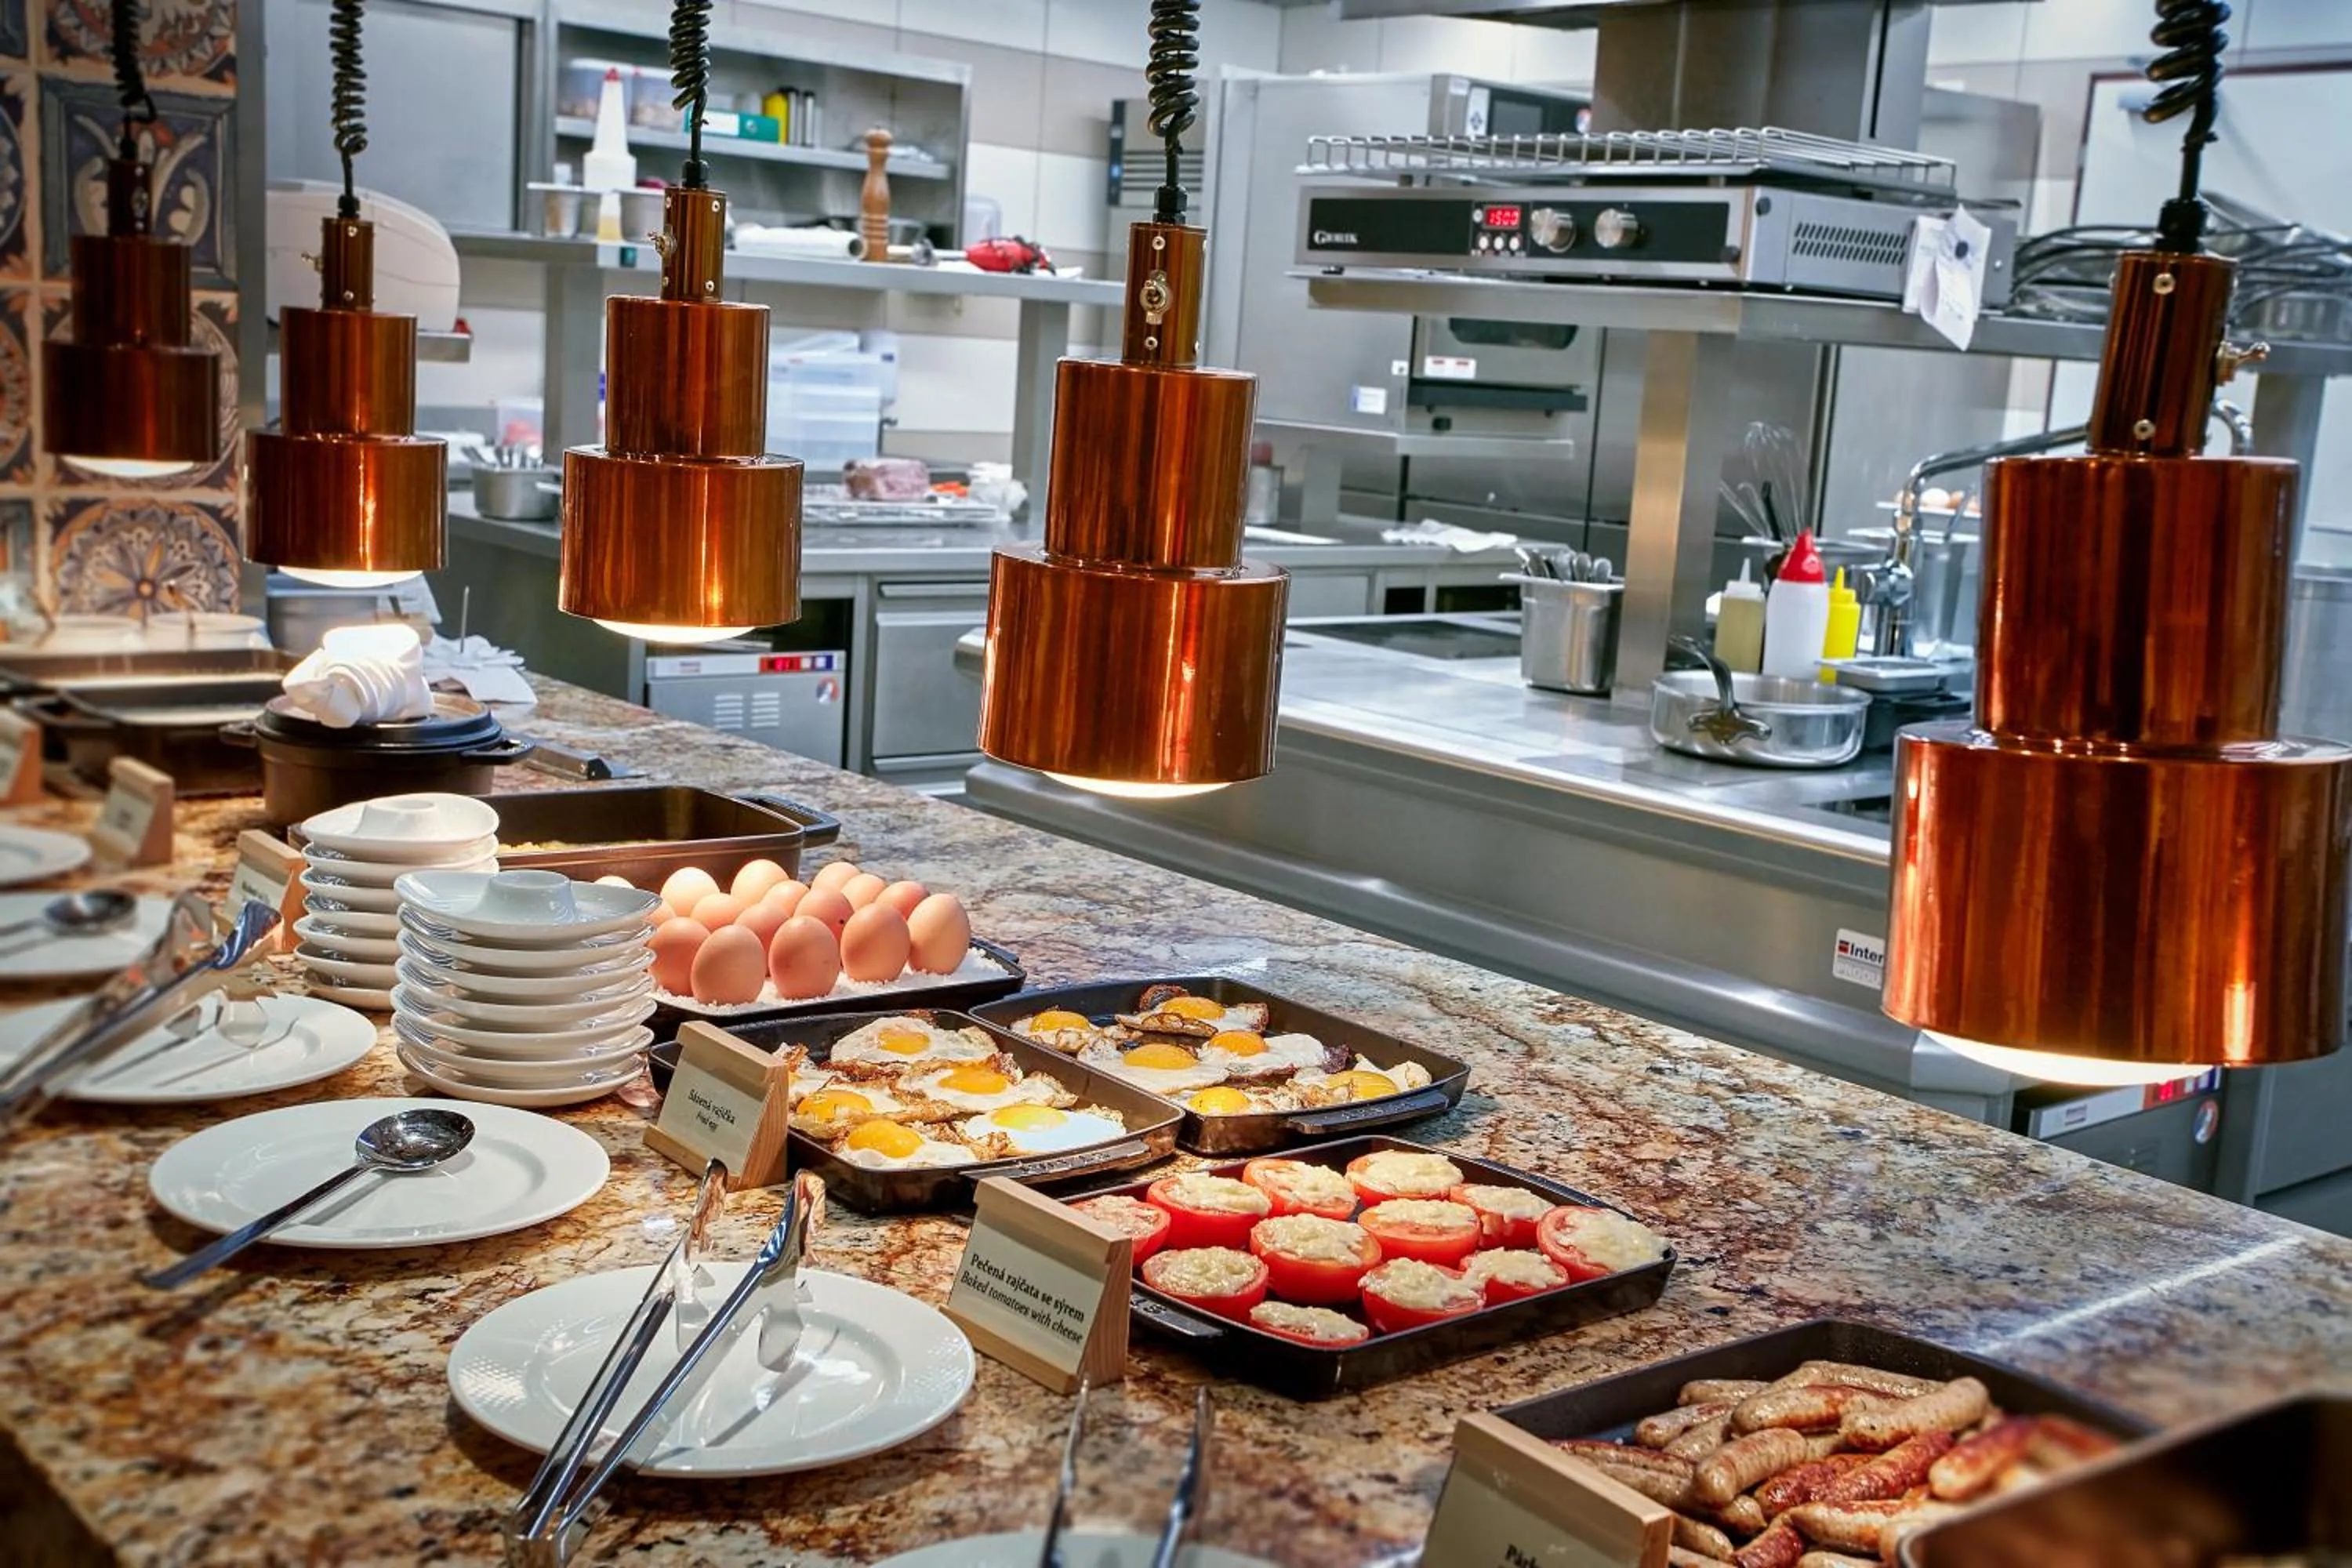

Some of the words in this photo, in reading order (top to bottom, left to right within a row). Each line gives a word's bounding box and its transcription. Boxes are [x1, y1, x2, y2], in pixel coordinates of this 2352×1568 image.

[960, 1270, 990, 1294] Baked
[988, 1286, 1030, 1316] tomatoes
[1031, 1306, 1051, 1328] with
[1051, 1319, 1083, 1345] cheese
[971, 1254, 1006, 1282] Pečená
[1006, 1274, 1040, 1299] rajčata
[1041, 1292, 1053, 1305] se
[1054, 1298, 1085, 1323] sýrem
